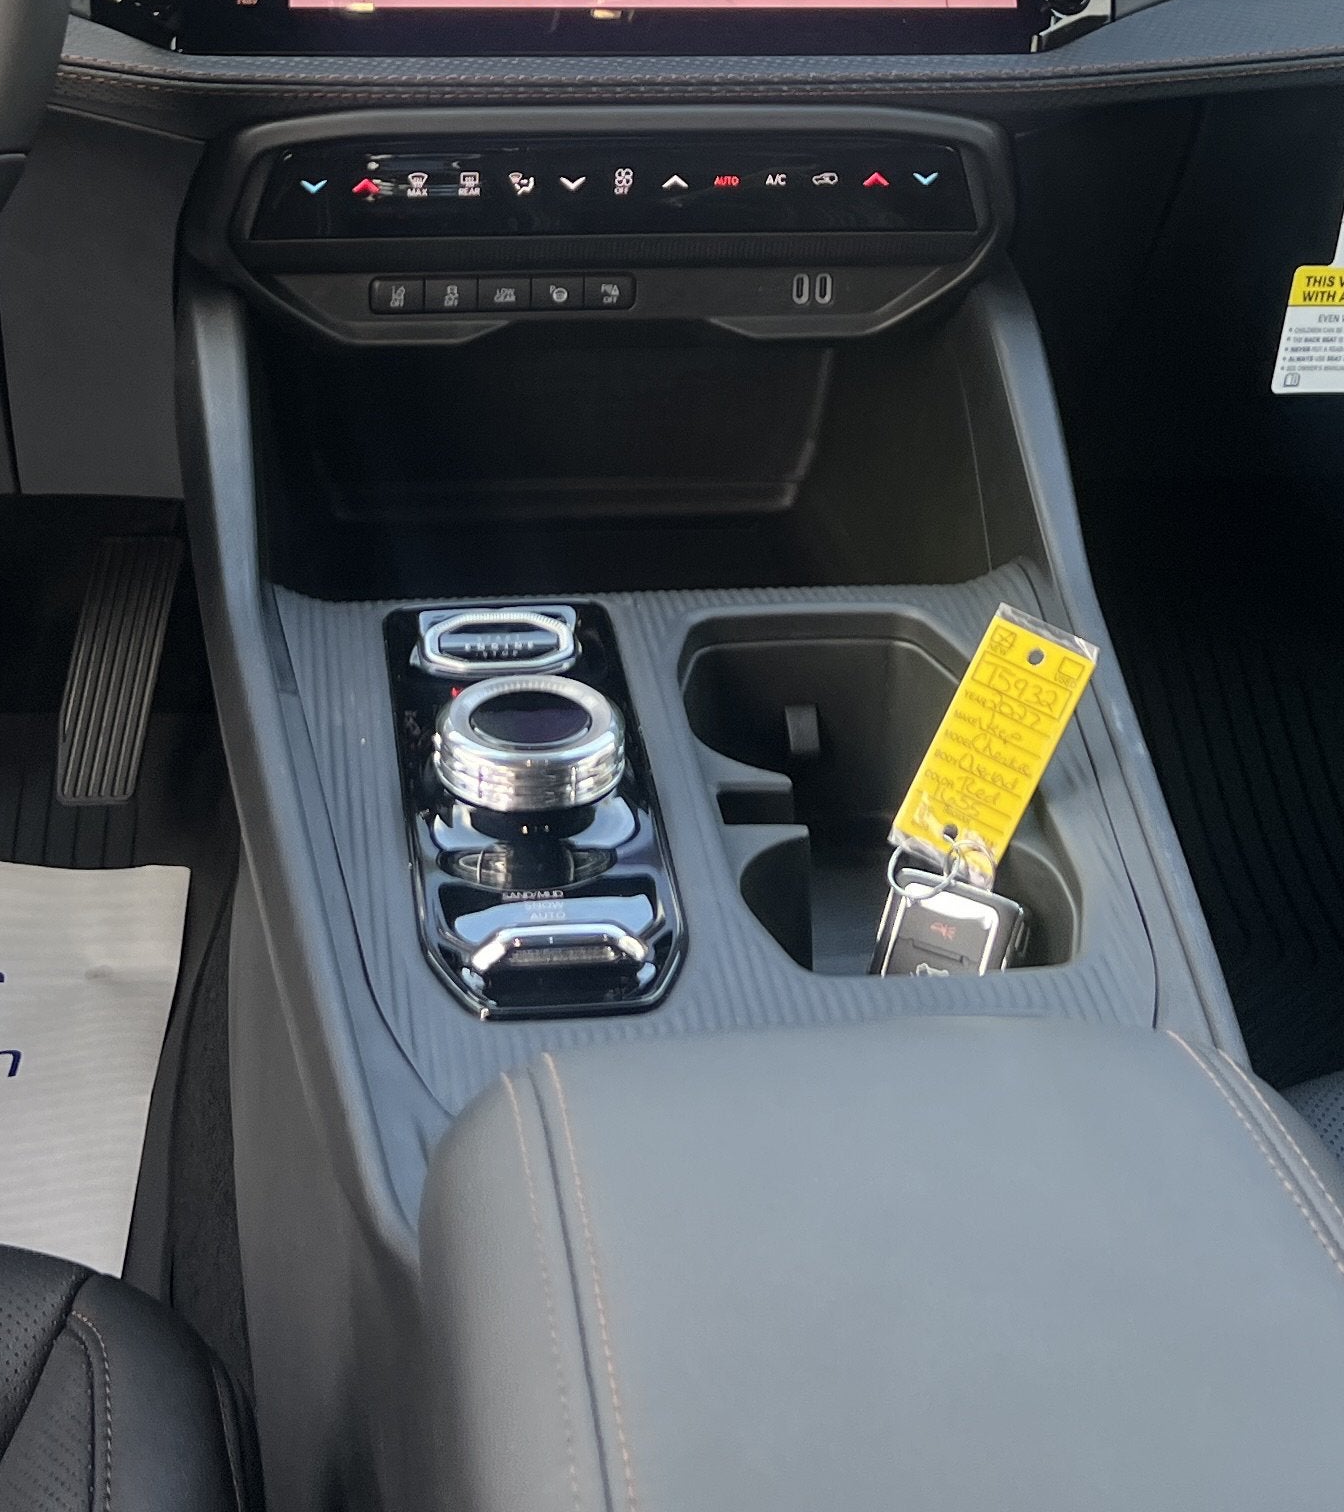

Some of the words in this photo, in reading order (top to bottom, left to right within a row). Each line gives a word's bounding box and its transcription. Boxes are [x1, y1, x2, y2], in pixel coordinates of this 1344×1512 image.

[713, 175, 740, 186] AUTO
[765, 173, 787, 186] A/C
[407, 188, 428, 197] MAX
[458, 188, 481, 196] REAR
[1306, 275, 1335, 287] THIS
[1303, 291, 1335, 303] WITH
[1318, 314, 1339, 323] EVEN
[964, 689, 988, 707] YEAR
[924, 768, 955, 789] COLOR
[502, 890, 565, 899] SAND/MUD
[524, 901, 564, 910] SNOW
[529, 912, 566, 920] AUTO
